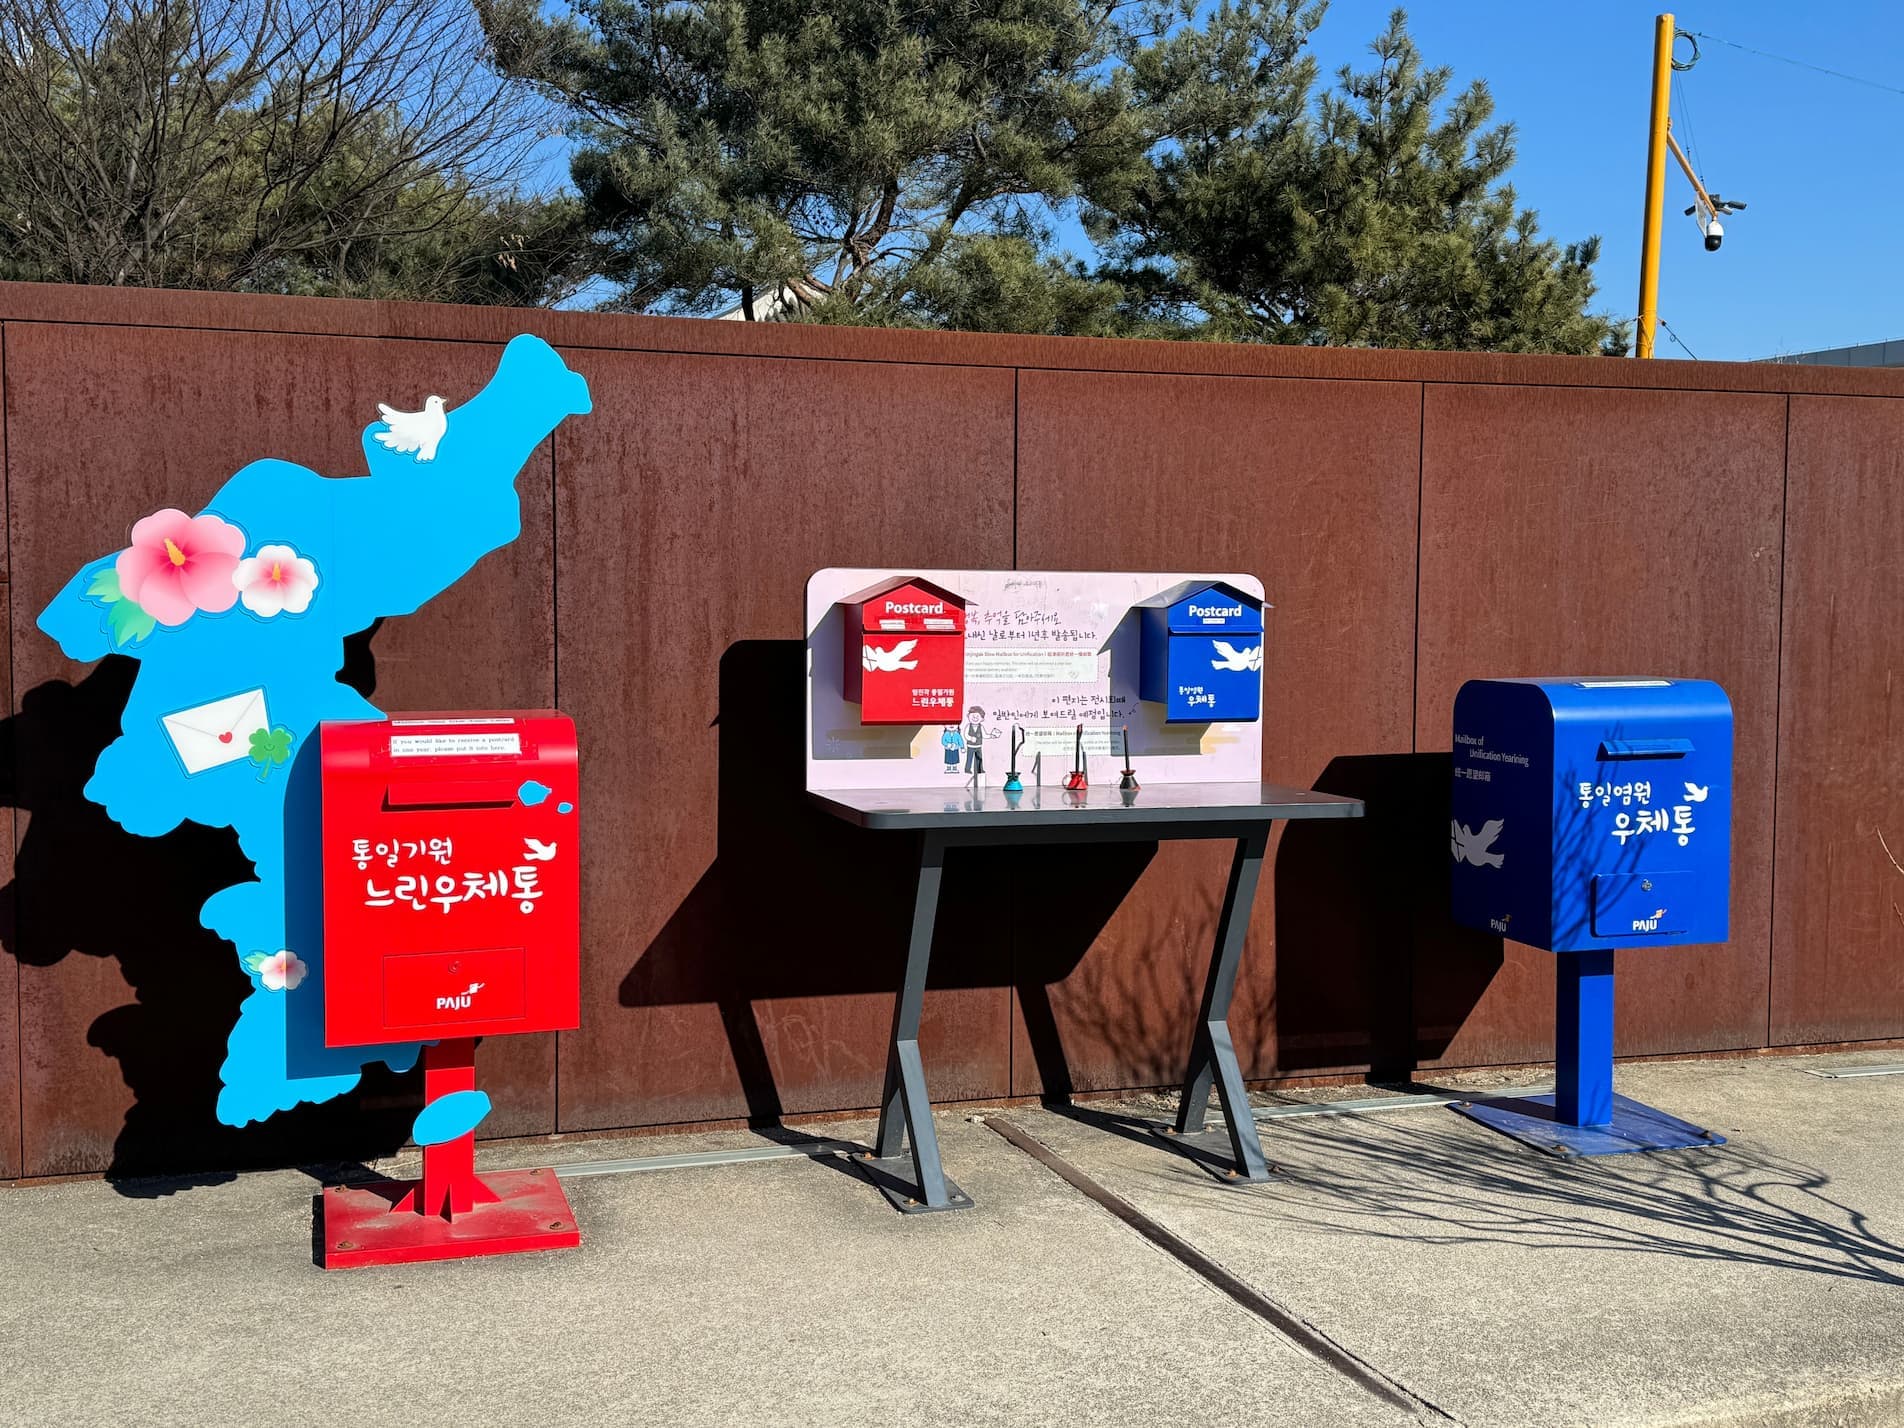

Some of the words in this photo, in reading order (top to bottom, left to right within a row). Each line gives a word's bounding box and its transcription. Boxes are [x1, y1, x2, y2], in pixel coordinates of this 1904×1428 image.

[885, 601, 944, 614] Postcard
[1188, 604, 1242, 617] Postcard
[984, 610, 1010, 626] 추억을
[1014, 610, 1061, 626] 담아주세요
[965, 630, 986, 640] 내신
[989, 630, 1025, 641] 날로부터
[1052, 630, 1097, 641] 발송됩니다.
[1052, 695, 1060, 704] 이
[1062, 694, 1089, 706] 편지는
[1187, 694, 1217, 708] 우체통
[992, 709, 1039, 721] 일반인에게
[1079, 709, 1125, 721] 예정입니다.
[1455, 734, 1478, 745] Mailbox
[1478, 735, 1485, 746] of
[1469, 748, 1501, 761] Unification
[1578, 780, 1652, 809] 통일염원
[1611, 805, 1696, 847] 우체통
[352, 837, 453, 870] 통일기원
[364, 866, 544, 914] 느린우체통
[1490, 918, 1507, 932] PAJU
[1632, 919, 1658, 932] PAJU
[436, 995, 472, 1011] PAJU
